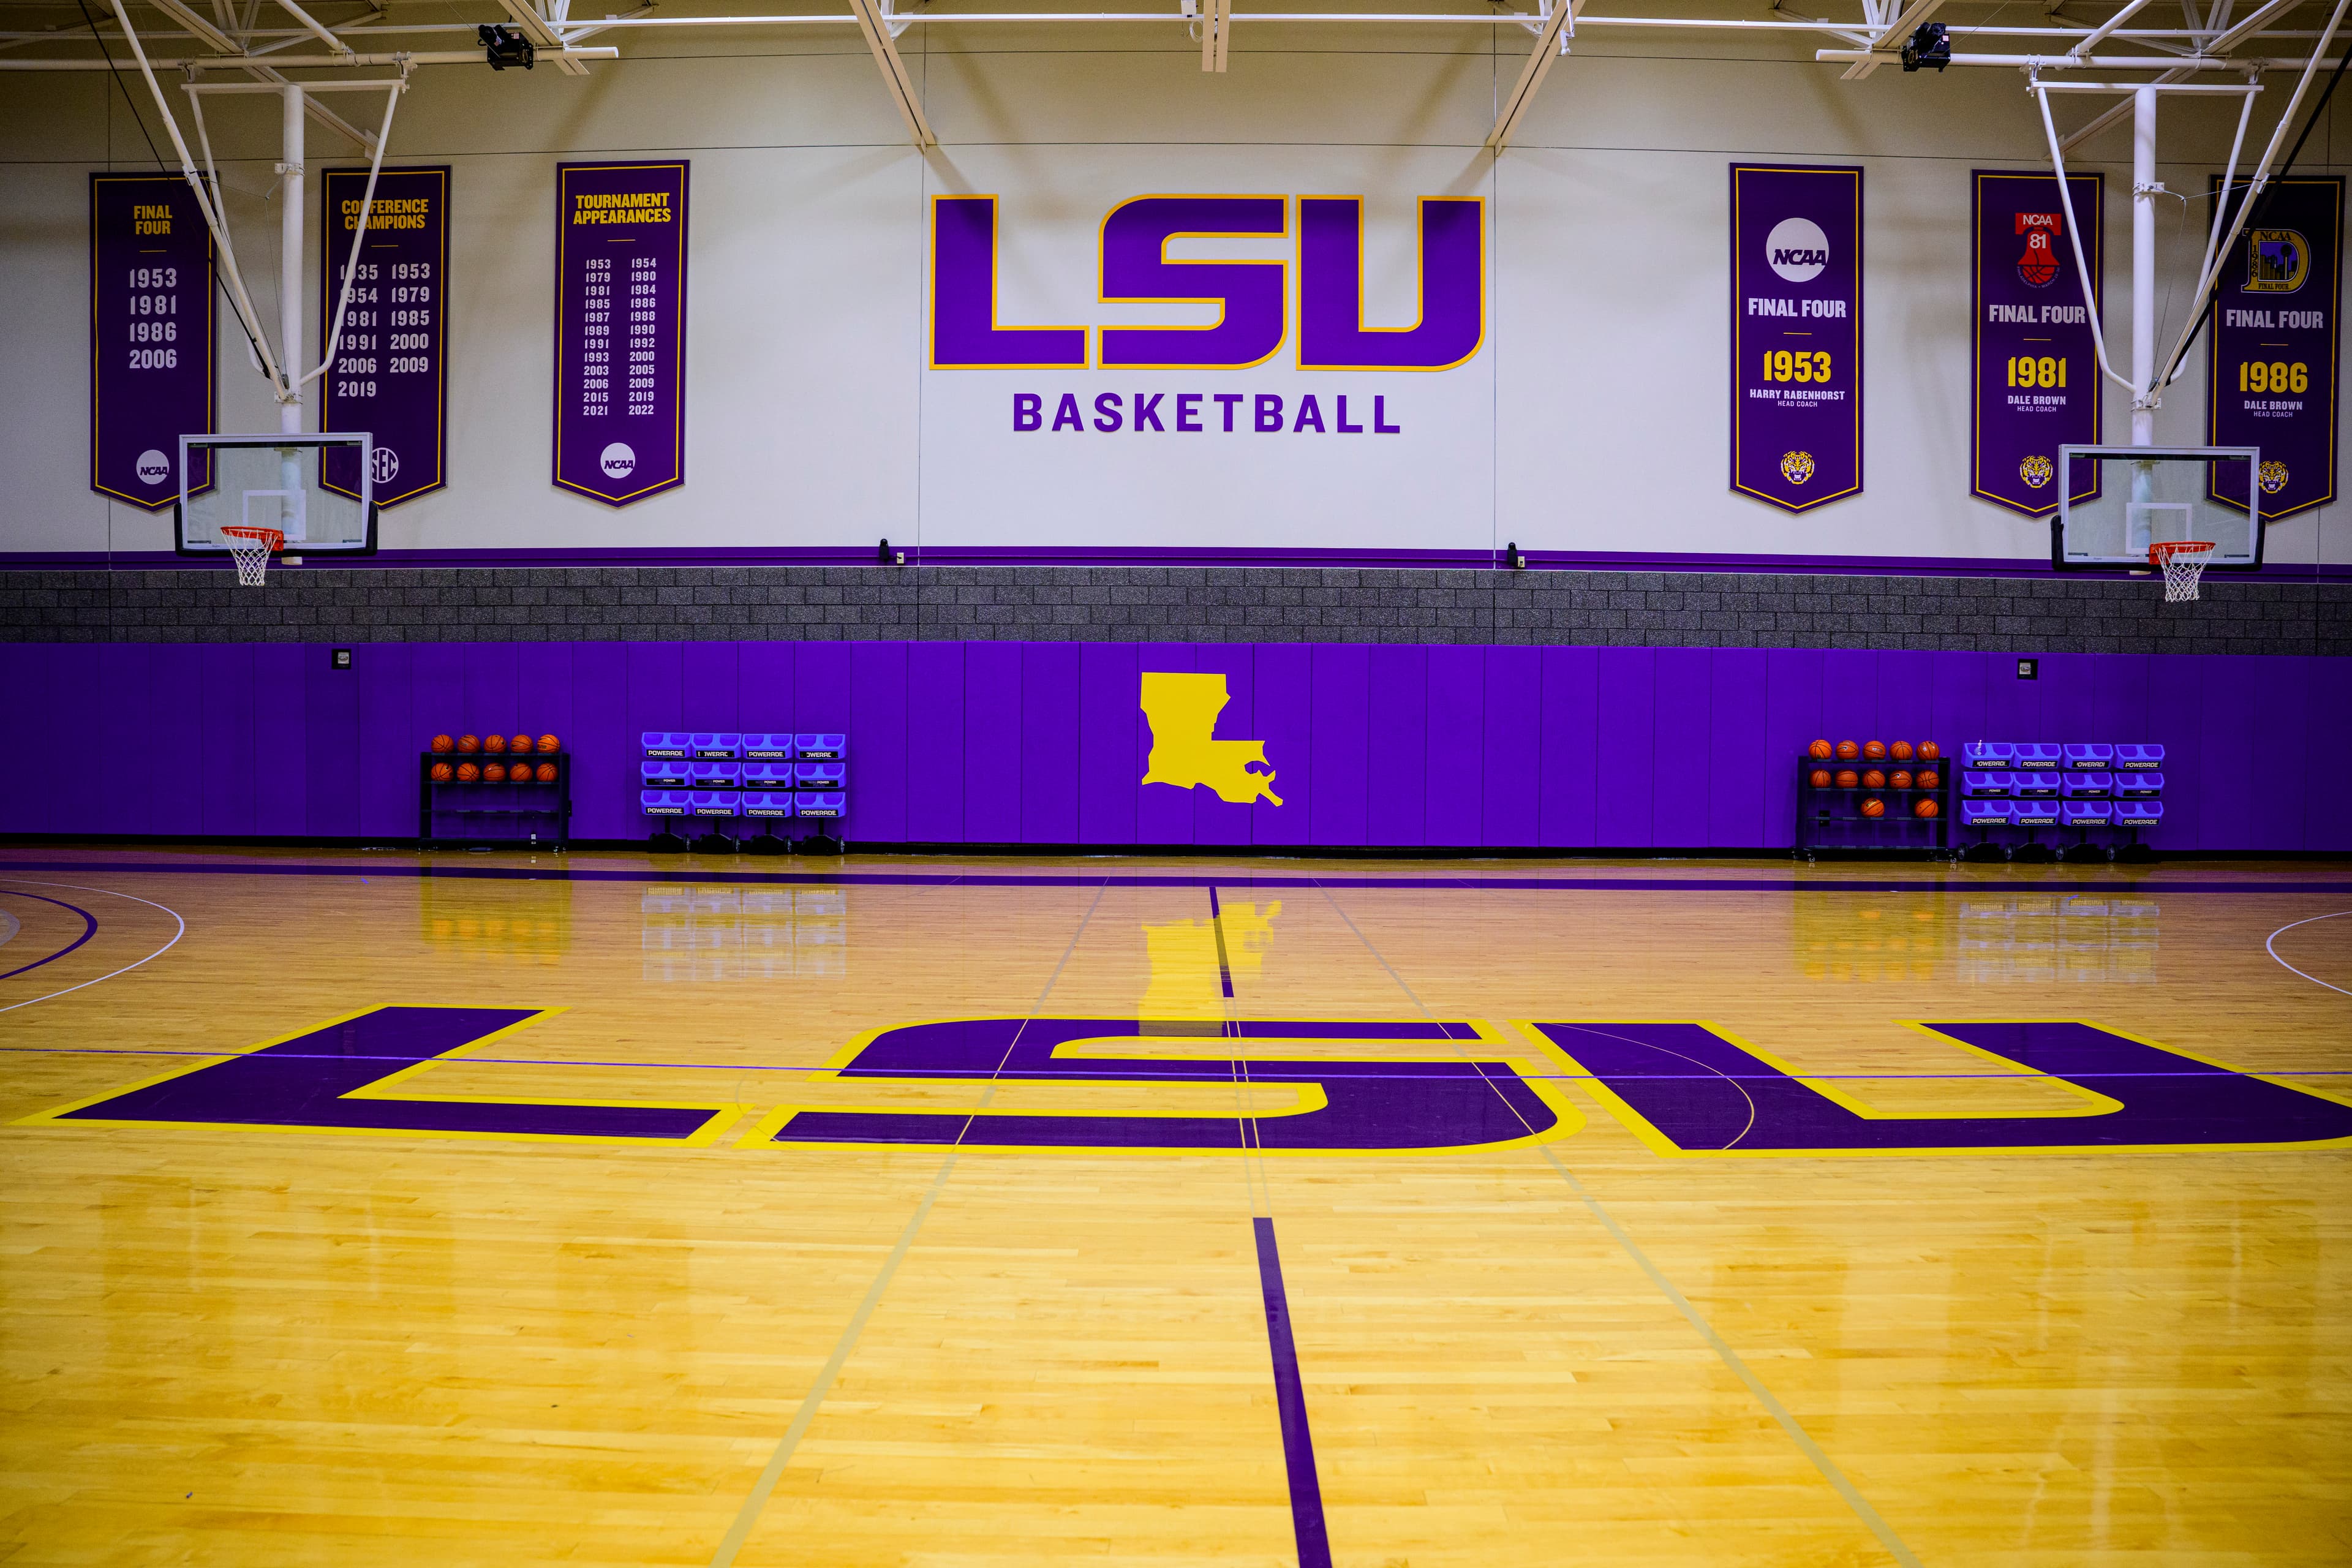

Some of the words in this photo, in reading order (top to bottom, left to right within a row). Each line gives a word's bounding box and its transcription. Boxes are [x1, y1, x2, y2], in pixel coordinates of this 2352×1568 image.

[576, 193, 669, 209] TOURNAMENT
[134, 205, 172, 219] FINAL
[573, 208, 671, 224] APPEARANCES
[2023, 214, 2052, 225] NCAA
[136, 221, 170, 235] FOUR
[2030, 233, 2046, 249] 81
[2260, 232, 2293, 241] NCAA
[587, 259, 610, 269] 1953
[632, 258, 656, 268] 1954
[1773, 249, 1826, 265] NCAA
[130, 268, 176, 288] 1953
[341, 265, 378, 279] 135
[392, 263, 430, 279] 1953
[586, 273, 610, 282] 1979
[631, 271, 656, 281] 1980
[586, 286, 609, 295] 1981
[631, 285, 656, 295] 1984
[929, 193, 1485, 372] LSU
[341, 288, 377, 303] 954
[392, 287, 429, 303] 1979
[130, 295, 176, 315] 1981
[586, 299, 609, 309] 1985
[631, 298, 655, 308] 1986
[1749, 298, 1798, 317] FINAL
[1802, 300, 1846, 317] FOUR
[391, 310, 429, 326] 1985
[586, 312, 609, 322] 1987
[631, 311, 655, 321] 1988
[1989, 305, 2037, 322] FINAL
[2041, 306, 2085, 323] FOUR
[2226, 309, 2274, 328] FINAL
[2279, 311, 2323, 328] FOUR
[130, 322, 176, 342] 1986
[585, 326, 609, 335] 1989
[631, 325, 655, 334] 1990
[339, 335, 376, 350] 1991
[390, 333, 428, 349] 2000
[585, 339, 608, 349] 1991
[630, 338, 655, 348] 1992
[129, 349, 176, 369] 2006
[585, 352, 609, 362] 1993
[630, 351, 654, 361] 2000
[339, 358, 376, 373] 2006
[390, 357, 428, 372] 2009
[584, 366, 608, 375] 2003
[630, 365, 654, 375] 2005
[1764, 351, 1831, 382] 1953
[2008, 357, 2066, 388] 1981
[584, 379, 608, 388] 2006
[629, 378, 654, 388] 2009
[2240, 362, 2307, 393] 1986
[338, 382, 376, 397] 2019
[584, 393, 608, 402] 2015
[629, 391, 654, 401] 2019
[1750, 389, 1781, 399] HARRY
[1784, 390, 1845, 400] RABENHORST
[2008, 396, 2030, 404] DALE
[2034, 396, 2065, 405] BROWN
[2244, 401, 2267, 409] DALE
[2270, 401, 2302, 410] BROWN
[583, 405, 608, 415] 2021
[629, 405, 654, 415] 2022
[1012, 393, 1400, 434] BASKETBALL
[140, 467, 168, 475] NCAA
[604, 461, 633, 469] NCAA
[9, 1005, 2352, 1158] LSU
